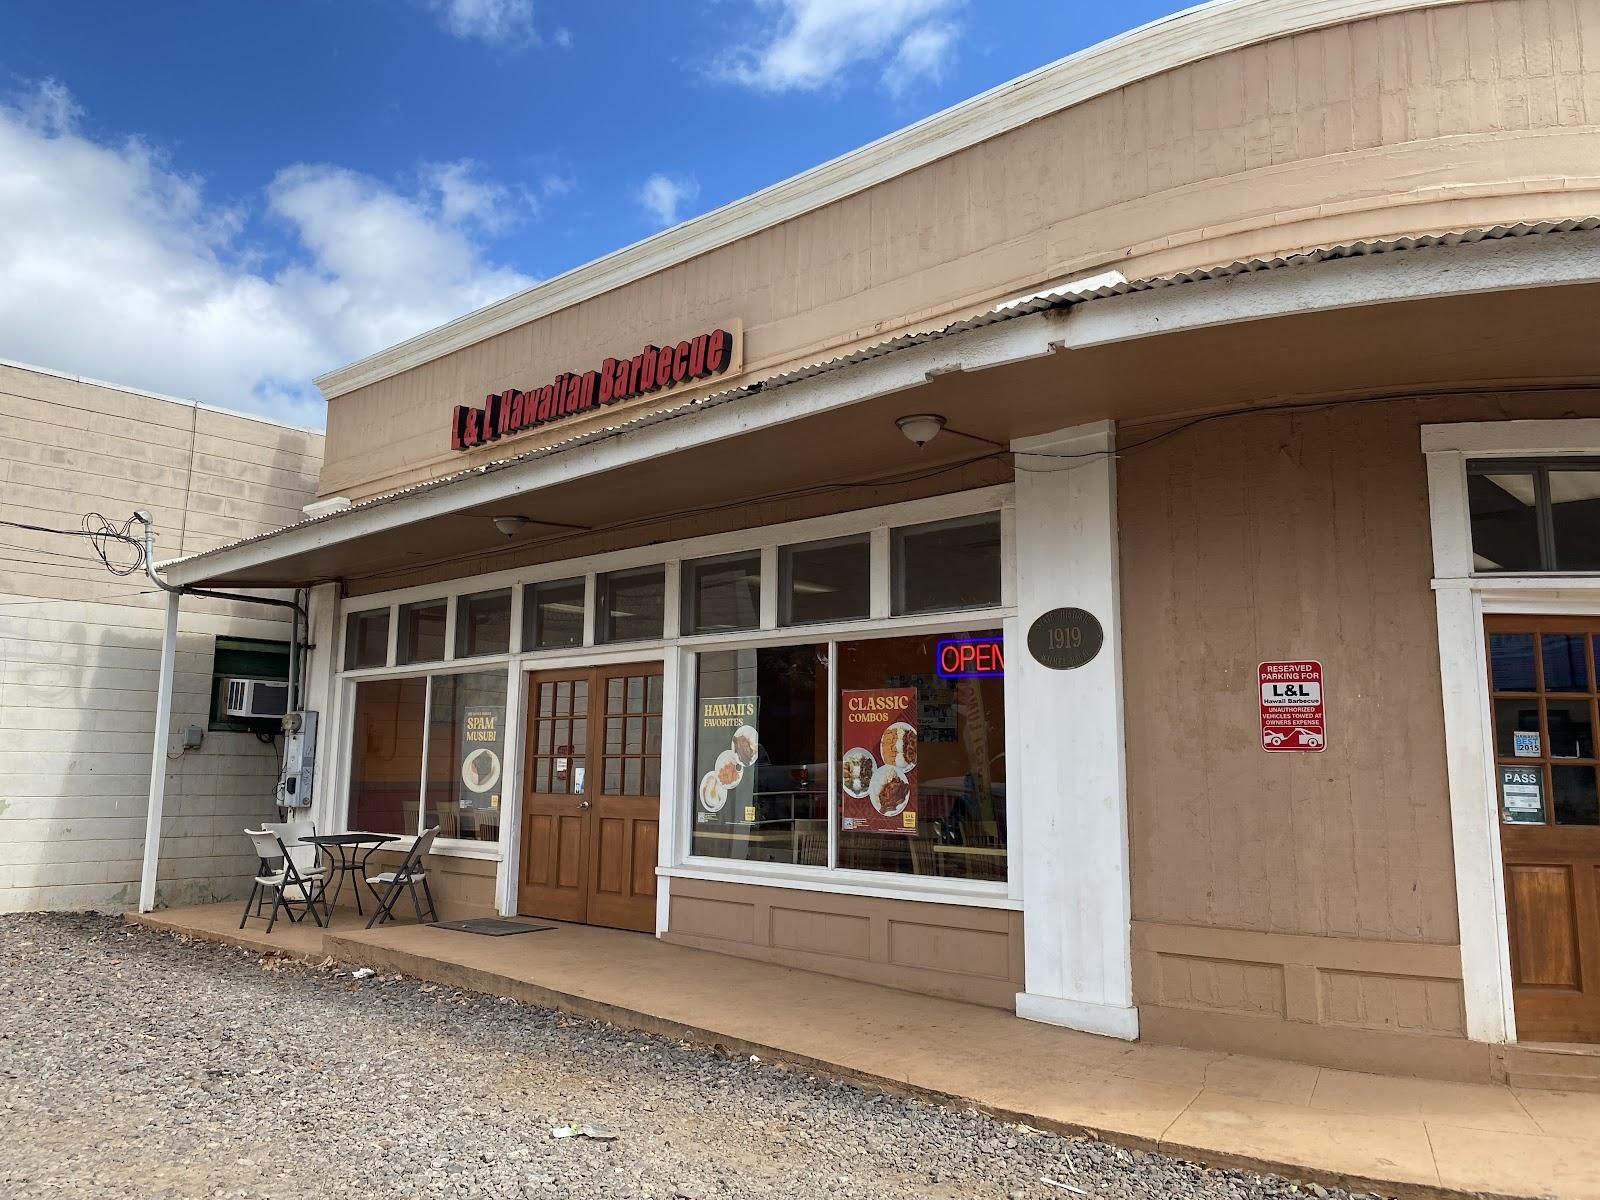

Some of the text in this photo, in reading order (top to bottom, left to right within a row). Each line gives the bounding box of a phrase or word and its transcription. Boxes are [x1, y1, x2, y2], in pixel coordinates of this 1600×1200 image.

[451, 328, 733, 450] L & L Hawaiian Barbecue
[1048, 626, 1082, 650] 1919
[941, 644, 1004, 672] OPEN
[1272, 684, 1310, 697] L&L
[704, 703, 754, 717] HAWAII'S
[849, 695, 909, 712] CLASSIC
[467, 717, 495, 730] SPAM
[703, 718, 744, 727] FAVORITES
[848, 712, 889, 723] COMBOS
[466, 731, 497, 742] MUSUBI
[1504, 773, 1537, 783] PASS
